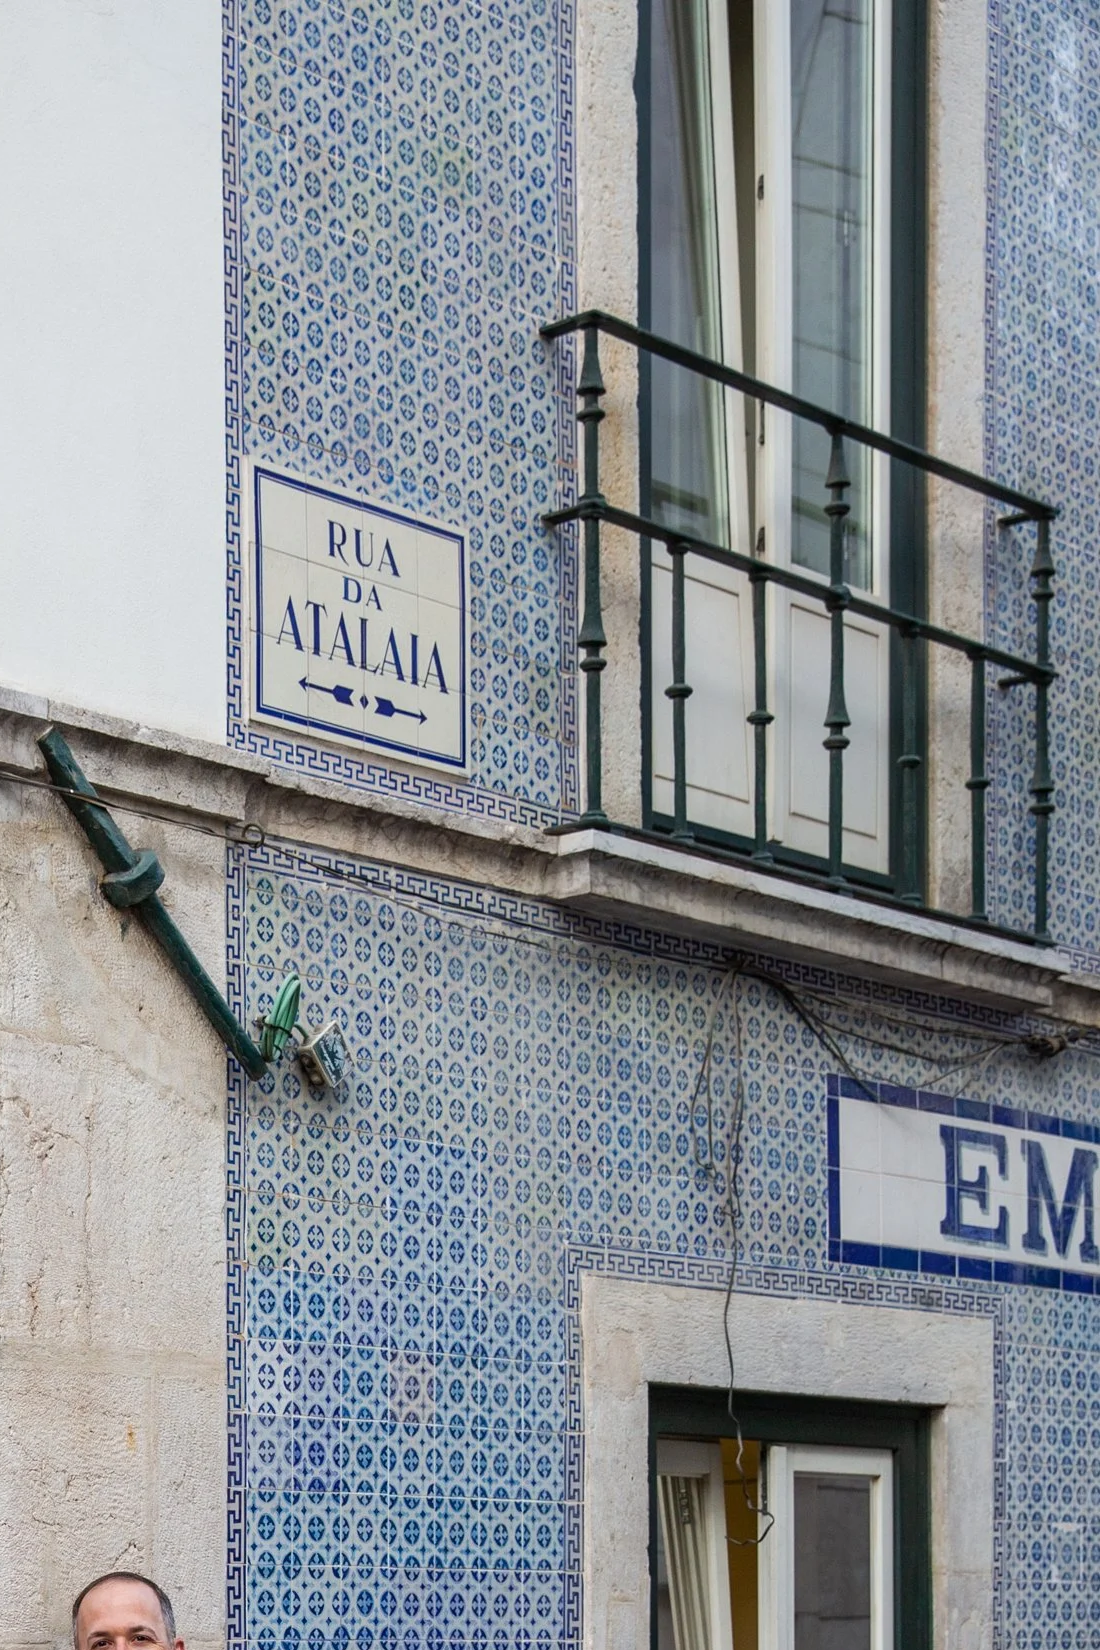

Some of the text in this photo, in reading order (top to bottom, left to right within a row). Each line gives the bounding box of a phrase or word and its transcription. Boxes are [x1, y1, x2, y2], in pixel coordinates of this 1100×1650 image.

[328, 520, 400, 578] RUA
[342, 576, 383, 612] DA
[276, 595, 449, 694] ATALAIA
[939, 1124, 1099, 1264] EM
